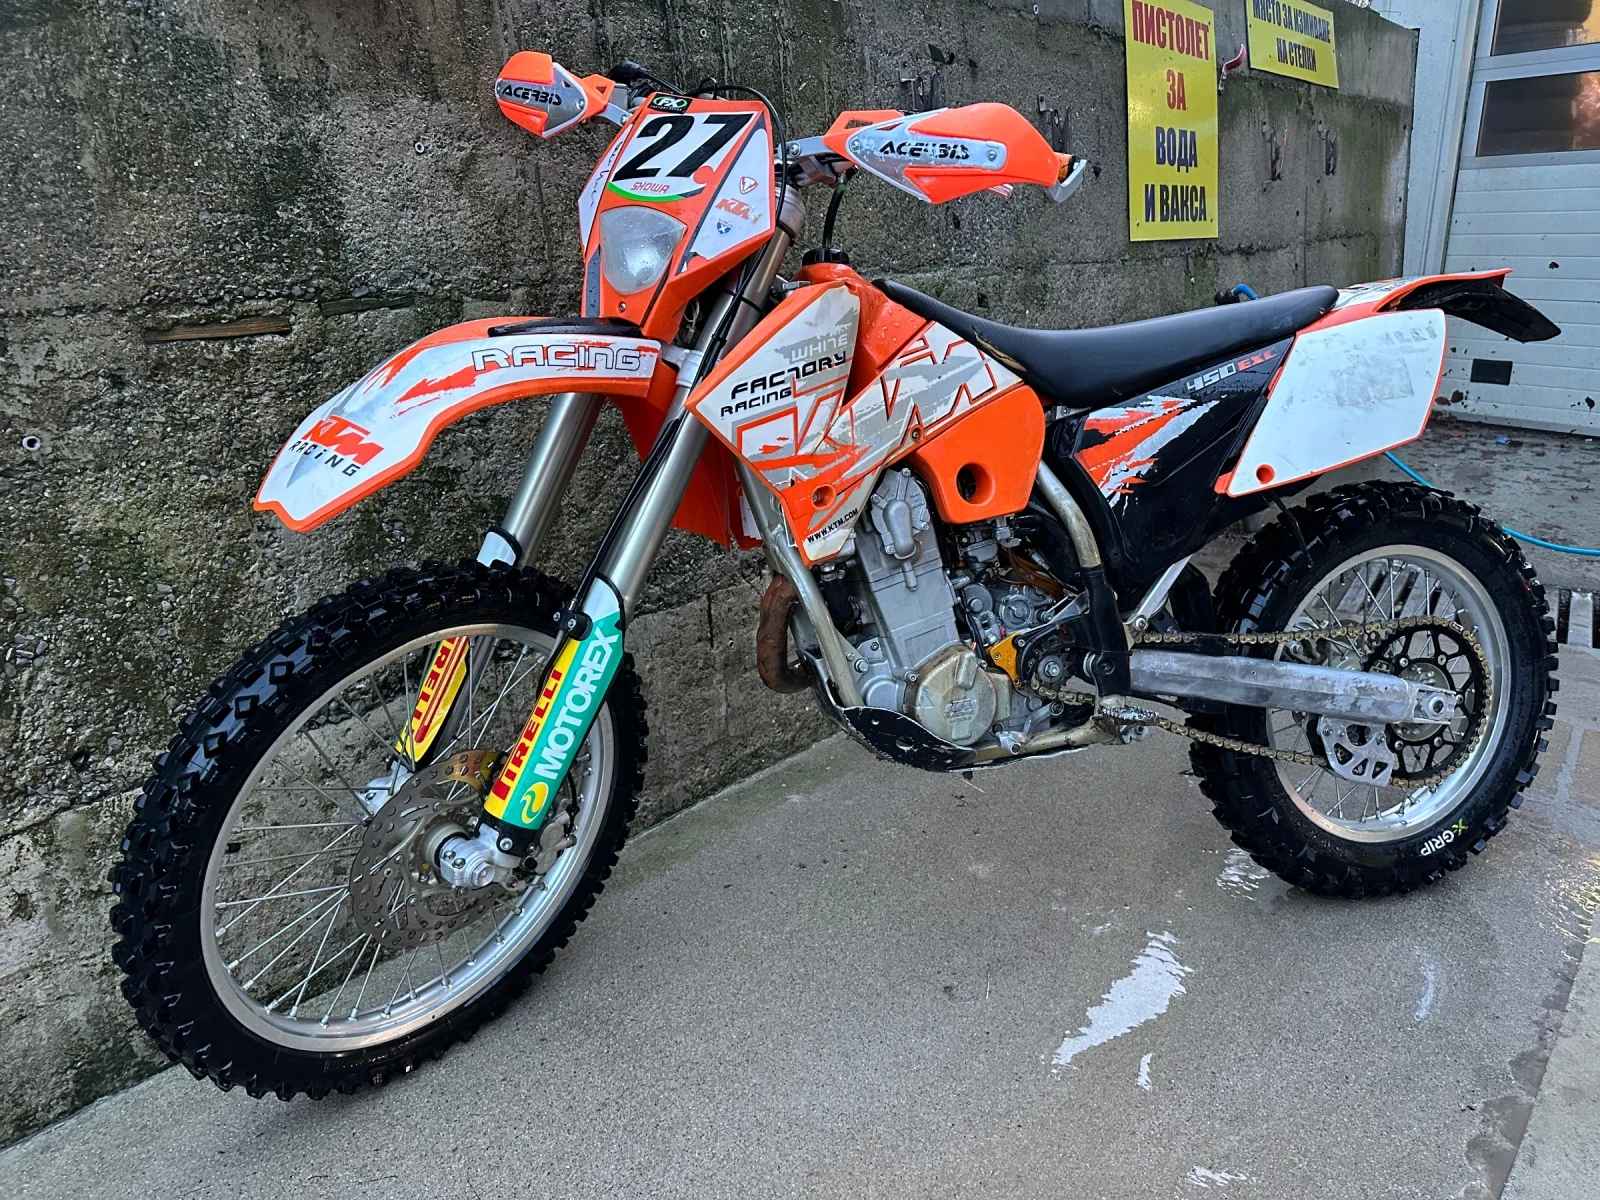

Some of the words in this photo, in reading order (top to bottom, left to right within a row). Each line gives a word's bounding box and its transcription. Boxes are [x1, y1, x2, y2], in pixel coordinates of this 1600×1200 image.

[1132, 1, 1209, 61] ПИСТОЛЕТ
[1282, 3, 1293, 31] ЗА
[1276, 37, 1288, 64] НА
[657, 97, 684, 108] FX
[1166, 69, 1187, 111] ЗА
[612, 113, 754, 182] 27
[1155, 126, 1198, 173] ВОДА
[629, 181, 671, 194] SHOWA
[1144, 183, 1156, 223] И
[1159, 185, 1207, 222] ВАКСА
[471, 345, 642, 372] RACING
[791, 333, 848, 363] WHITE
[731, 350, 847, 400] FACTORY
[1186, 362, 1237, 391] 450
[720, 387, 792, 417] RACING
[301, 414, 385, 467] KTM
[806, 507, 858, 543] WWW.KTM.COM
[534, 627, 619, 780] MOTOREX
[1420, 818, 1469, 857] X-GRIP
